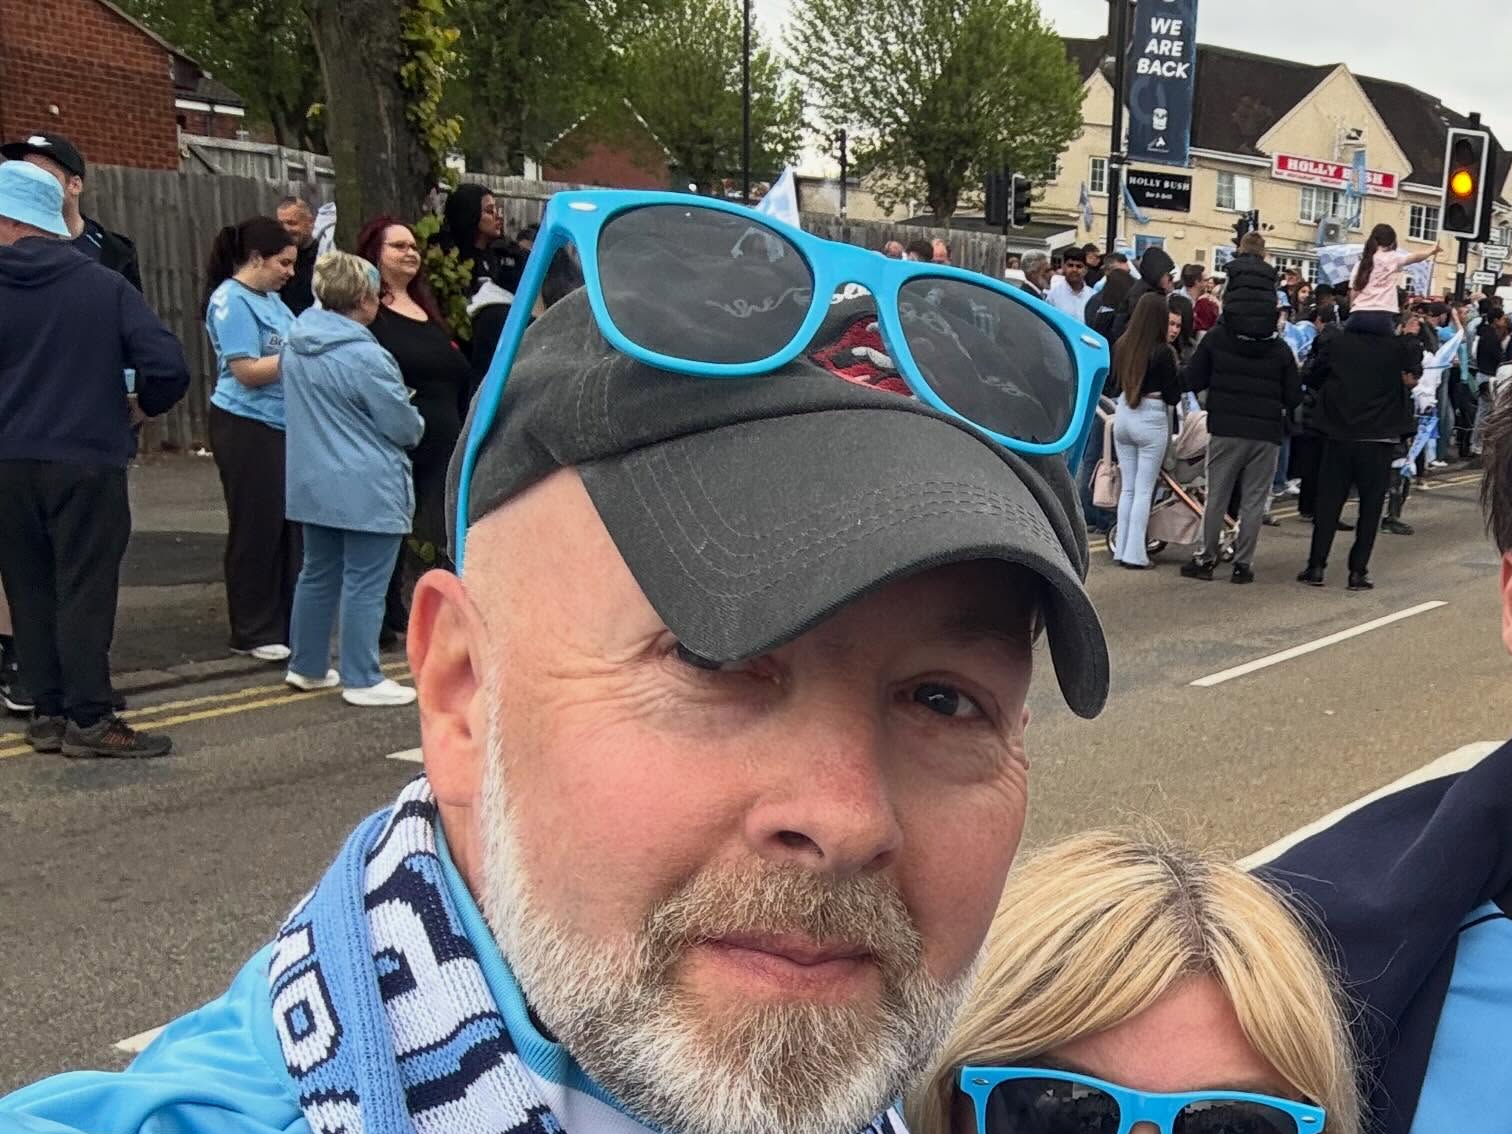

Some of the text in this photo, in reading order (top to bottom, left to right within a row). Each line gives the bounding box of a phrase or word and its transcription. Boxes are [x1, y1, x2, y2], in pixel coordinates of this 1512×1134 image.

[1151, 17, 1183, 36] WE
[1144, 38, 1184, 57] ARE
[1136, 58, 1190, 79] BACK
[1287, 158, 1337, 176] HOLLY
[1341, 168, 1384, 185] BSH
[1129, 176, 1190, 191] HOLLY BUSH
